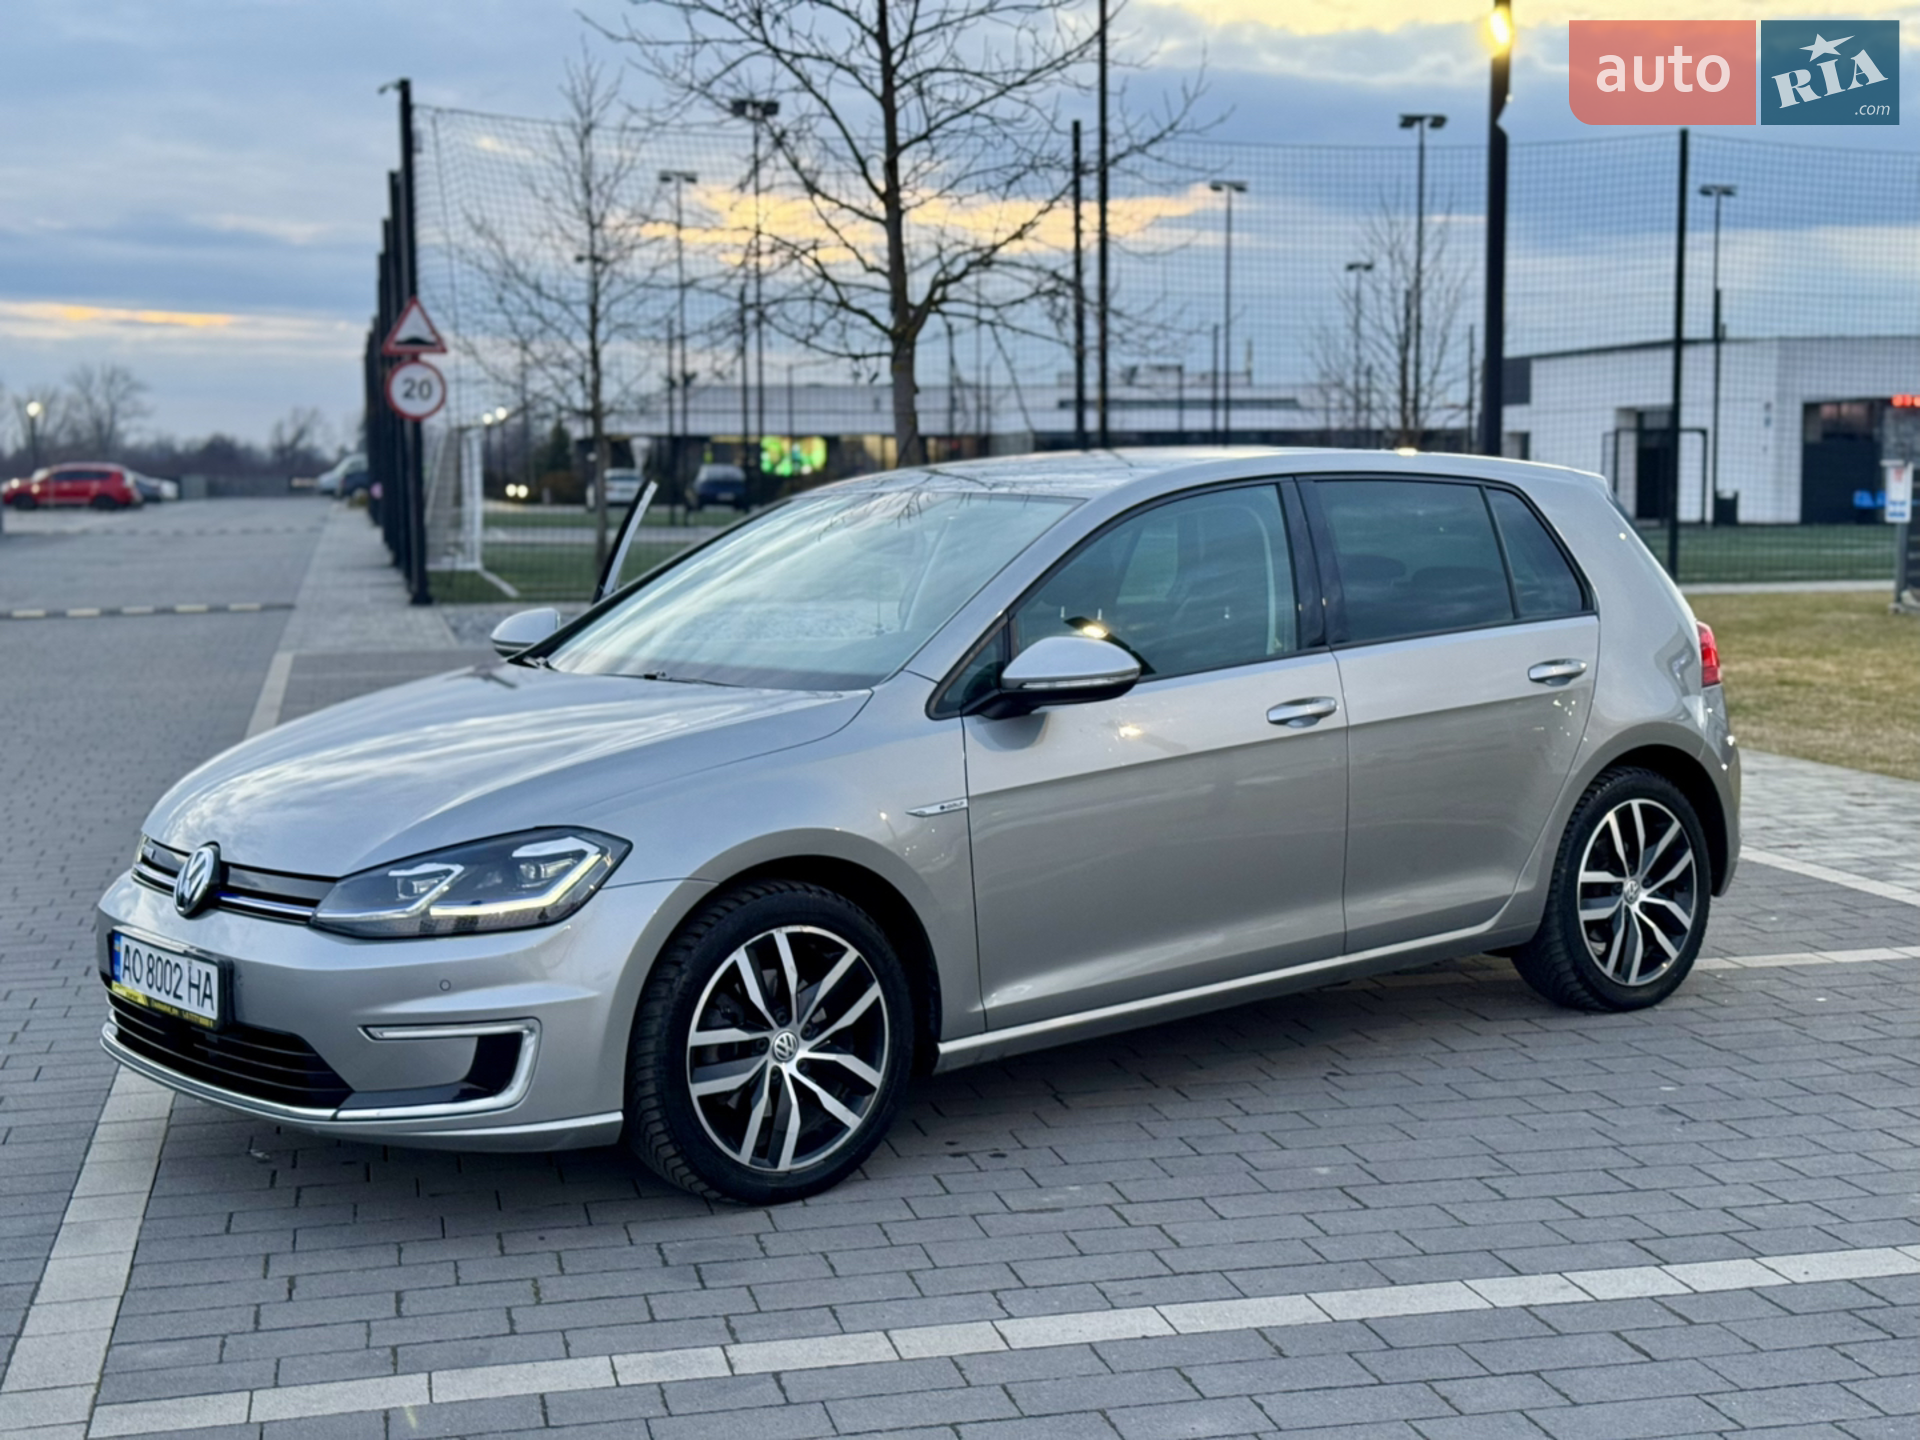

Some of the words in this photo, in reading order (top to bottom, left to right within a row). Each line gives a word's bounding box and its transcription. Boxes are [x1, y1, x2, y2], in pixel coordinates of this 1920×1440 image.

[402, 377, 433, 400] 20
[122, 944, 144, 984] AO
[146, 952, 184, 1000] 8002
[187, 965, 214, 1011] HA
